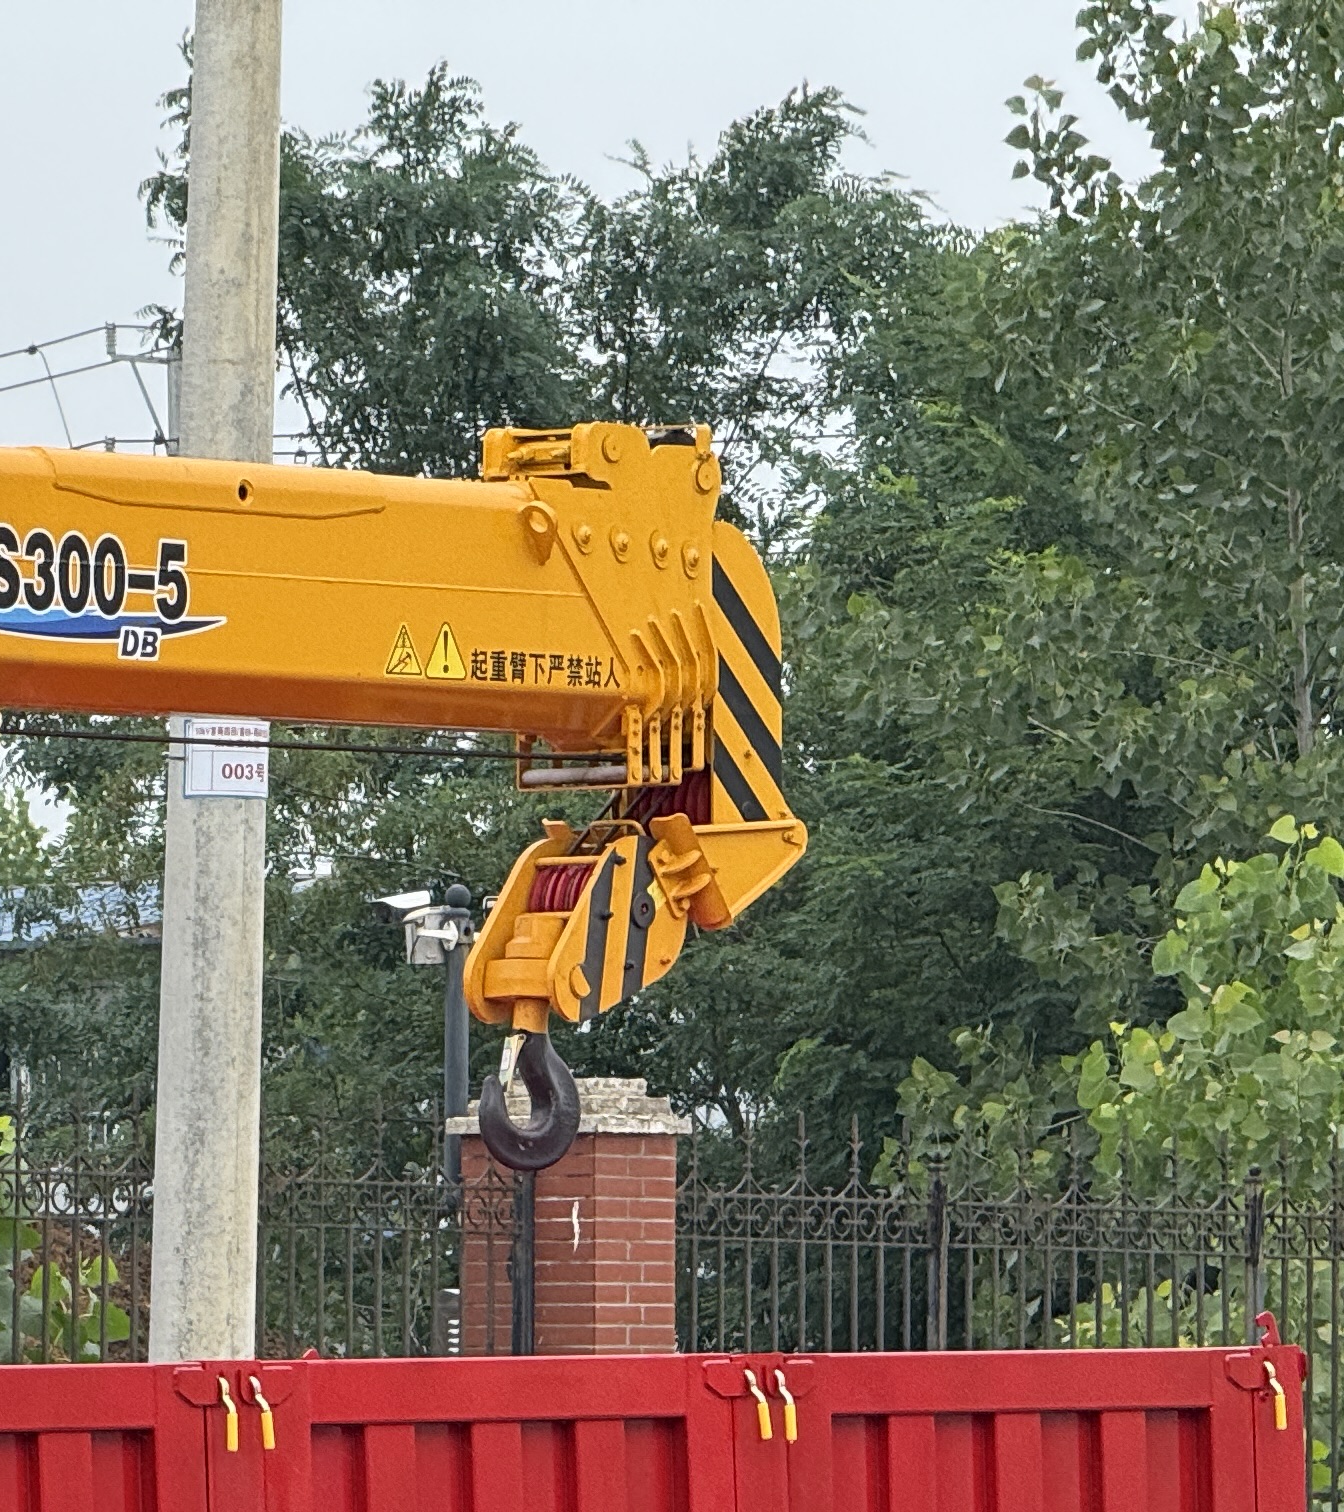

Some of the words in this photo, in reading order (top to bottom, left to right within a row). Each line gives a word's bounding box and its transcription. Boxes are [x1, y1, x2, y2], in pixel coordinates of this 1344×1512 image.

[121, 629, 159, 659] DB
[470, 649, 620, 689] 起重臂下严禁站人
[221, 763, 265, 783] 003号
